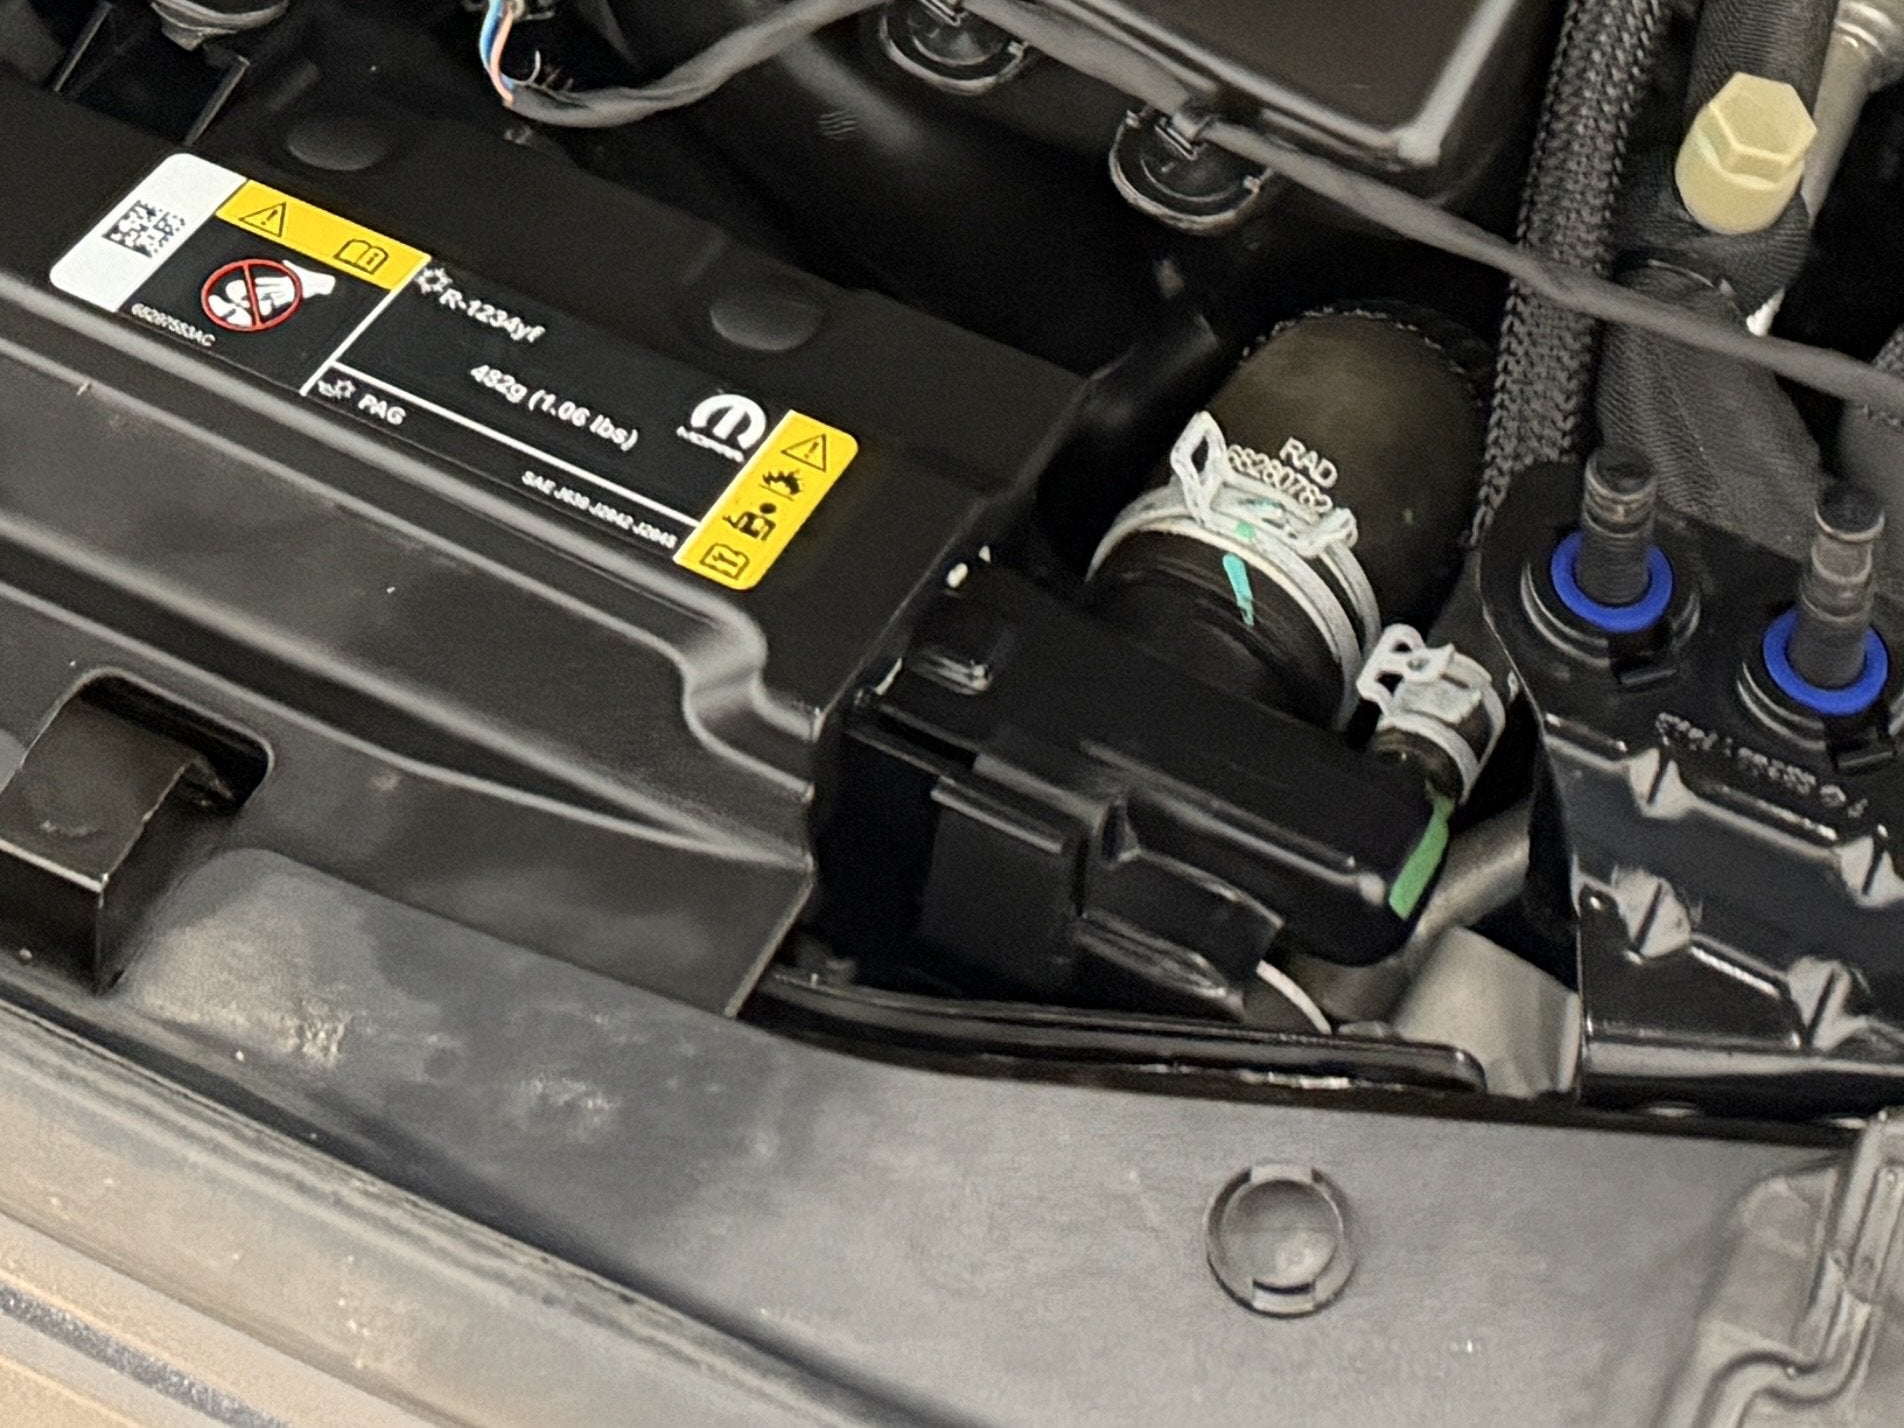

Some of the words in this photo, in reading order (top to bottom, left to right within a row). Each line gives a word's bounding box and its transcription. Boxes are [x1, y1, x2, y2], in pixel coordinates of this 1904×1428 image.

[439, 288, 546, 343] R-1234yf
[357, 393, 407, 425] PAG
[470, 364, 528, 404] 482g
[528, 389, 590, 427] (1.06
[589, 414, 639, 452] lbs)
[521, 470, 556, 495] SAE
[1279, 436, 1338, 489] RAD
